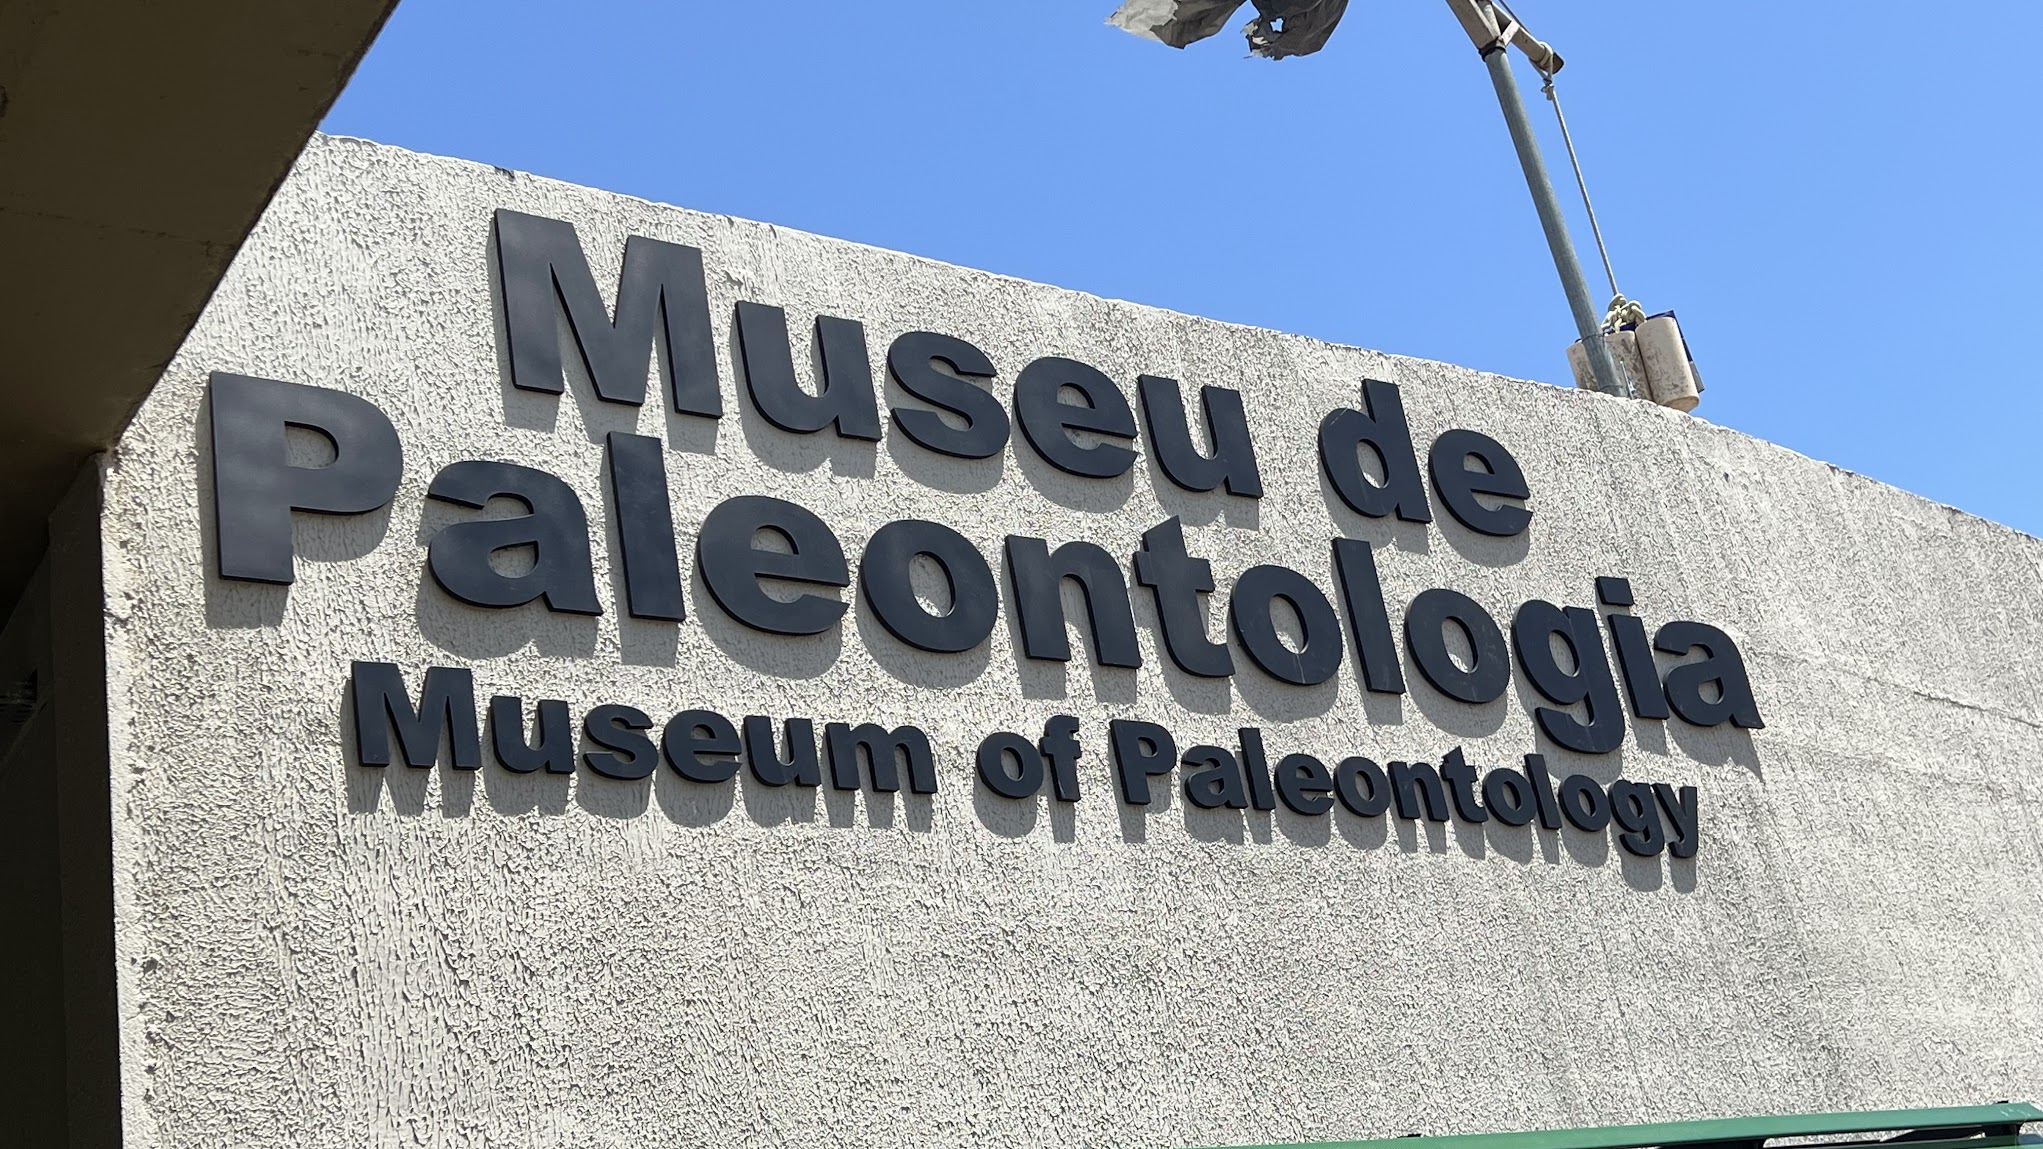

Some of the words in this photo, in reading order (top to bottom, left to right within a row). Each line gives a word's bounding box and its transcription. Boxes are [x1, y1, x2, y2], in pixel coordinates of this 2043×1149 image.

[494, 208, 1263, 499] Museu
[1318, 379, 1532, 537] de
[210, 371, 1765, 754] Paleontologia
[350, 660, 938, 794] Museum
[976, 715, 1083, 803] of
[1110, 719, 1698, 859] Paleontology
